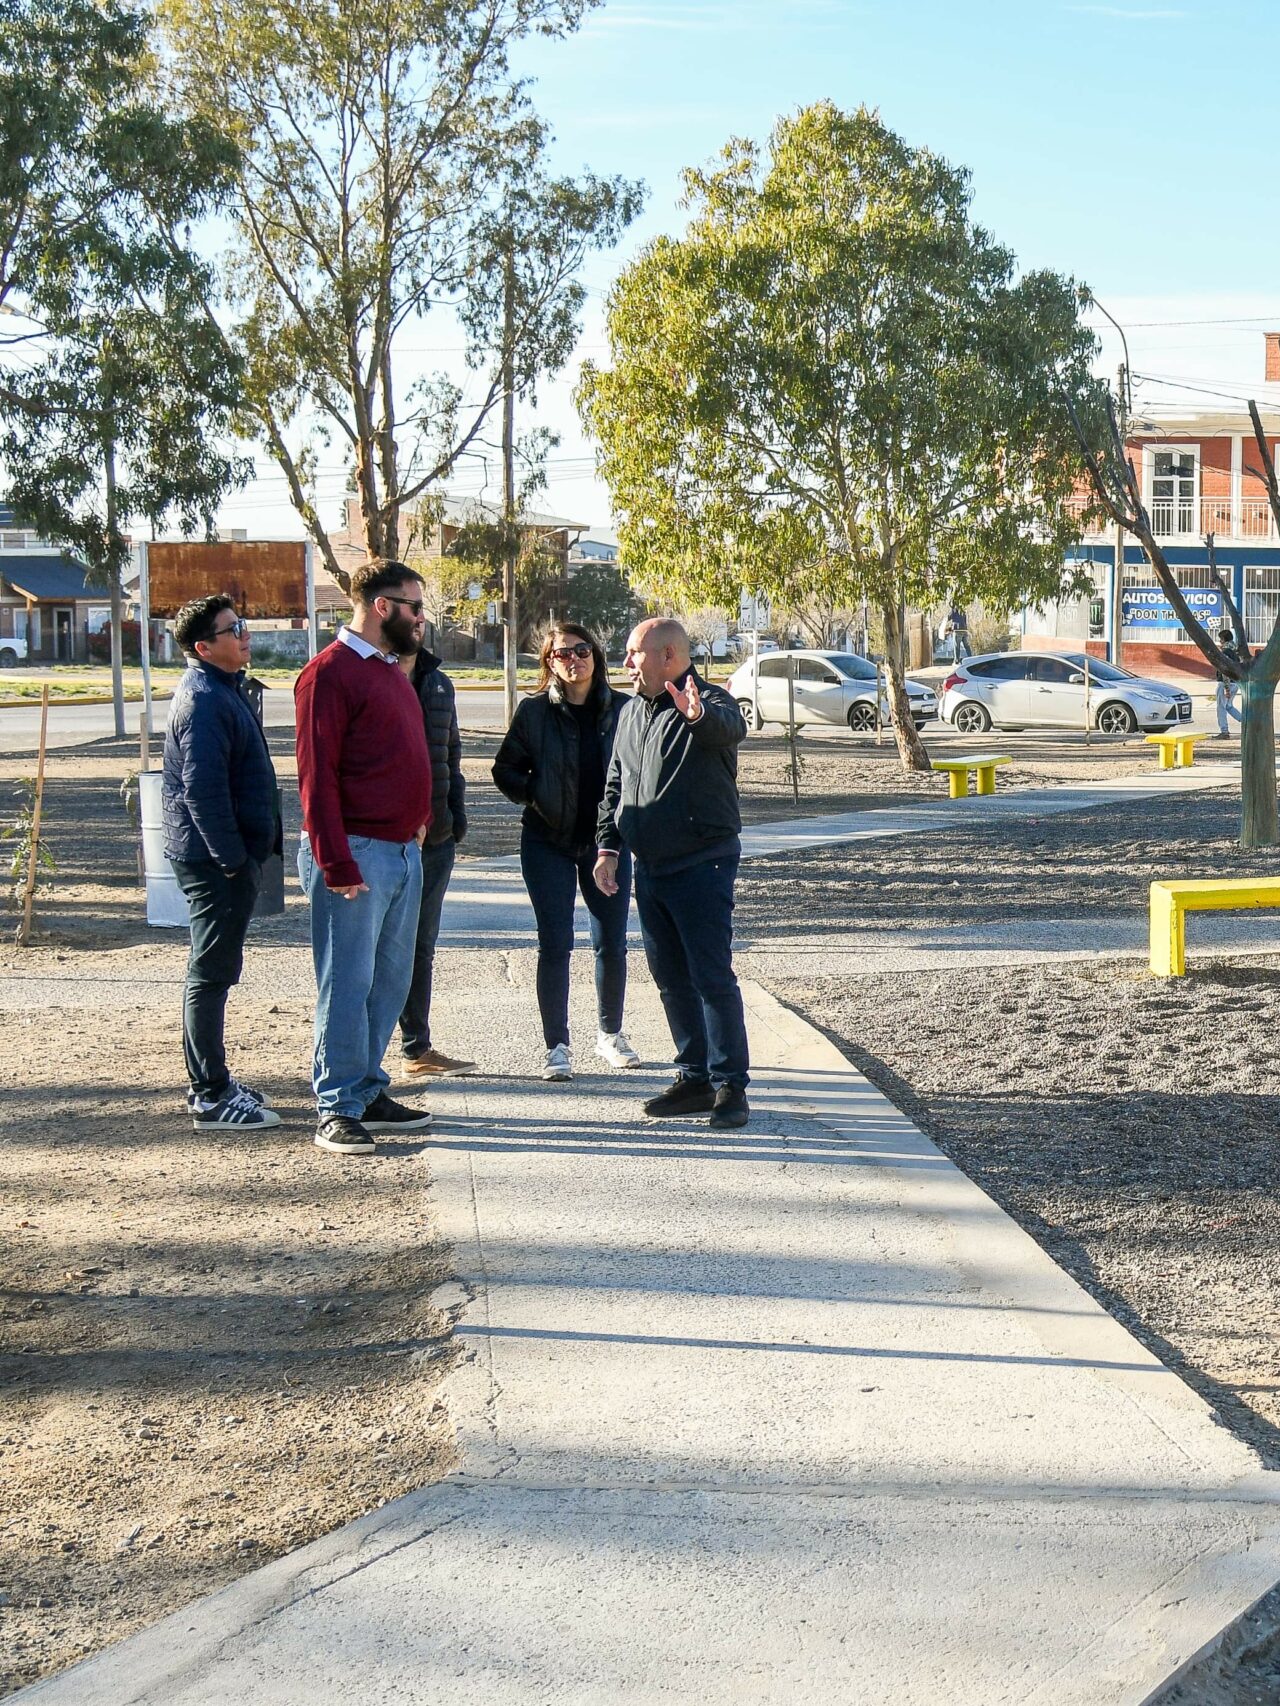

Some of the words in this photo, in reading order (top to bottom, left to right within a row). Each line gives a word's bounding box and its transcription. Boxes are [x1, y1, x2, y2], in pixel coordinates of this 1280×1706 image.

[1122, 592, 1218, 605] AUTOSVICIO
[1130, 608, 1158, 620] "DON
[1161, 609, 1211, 621] THAS"
